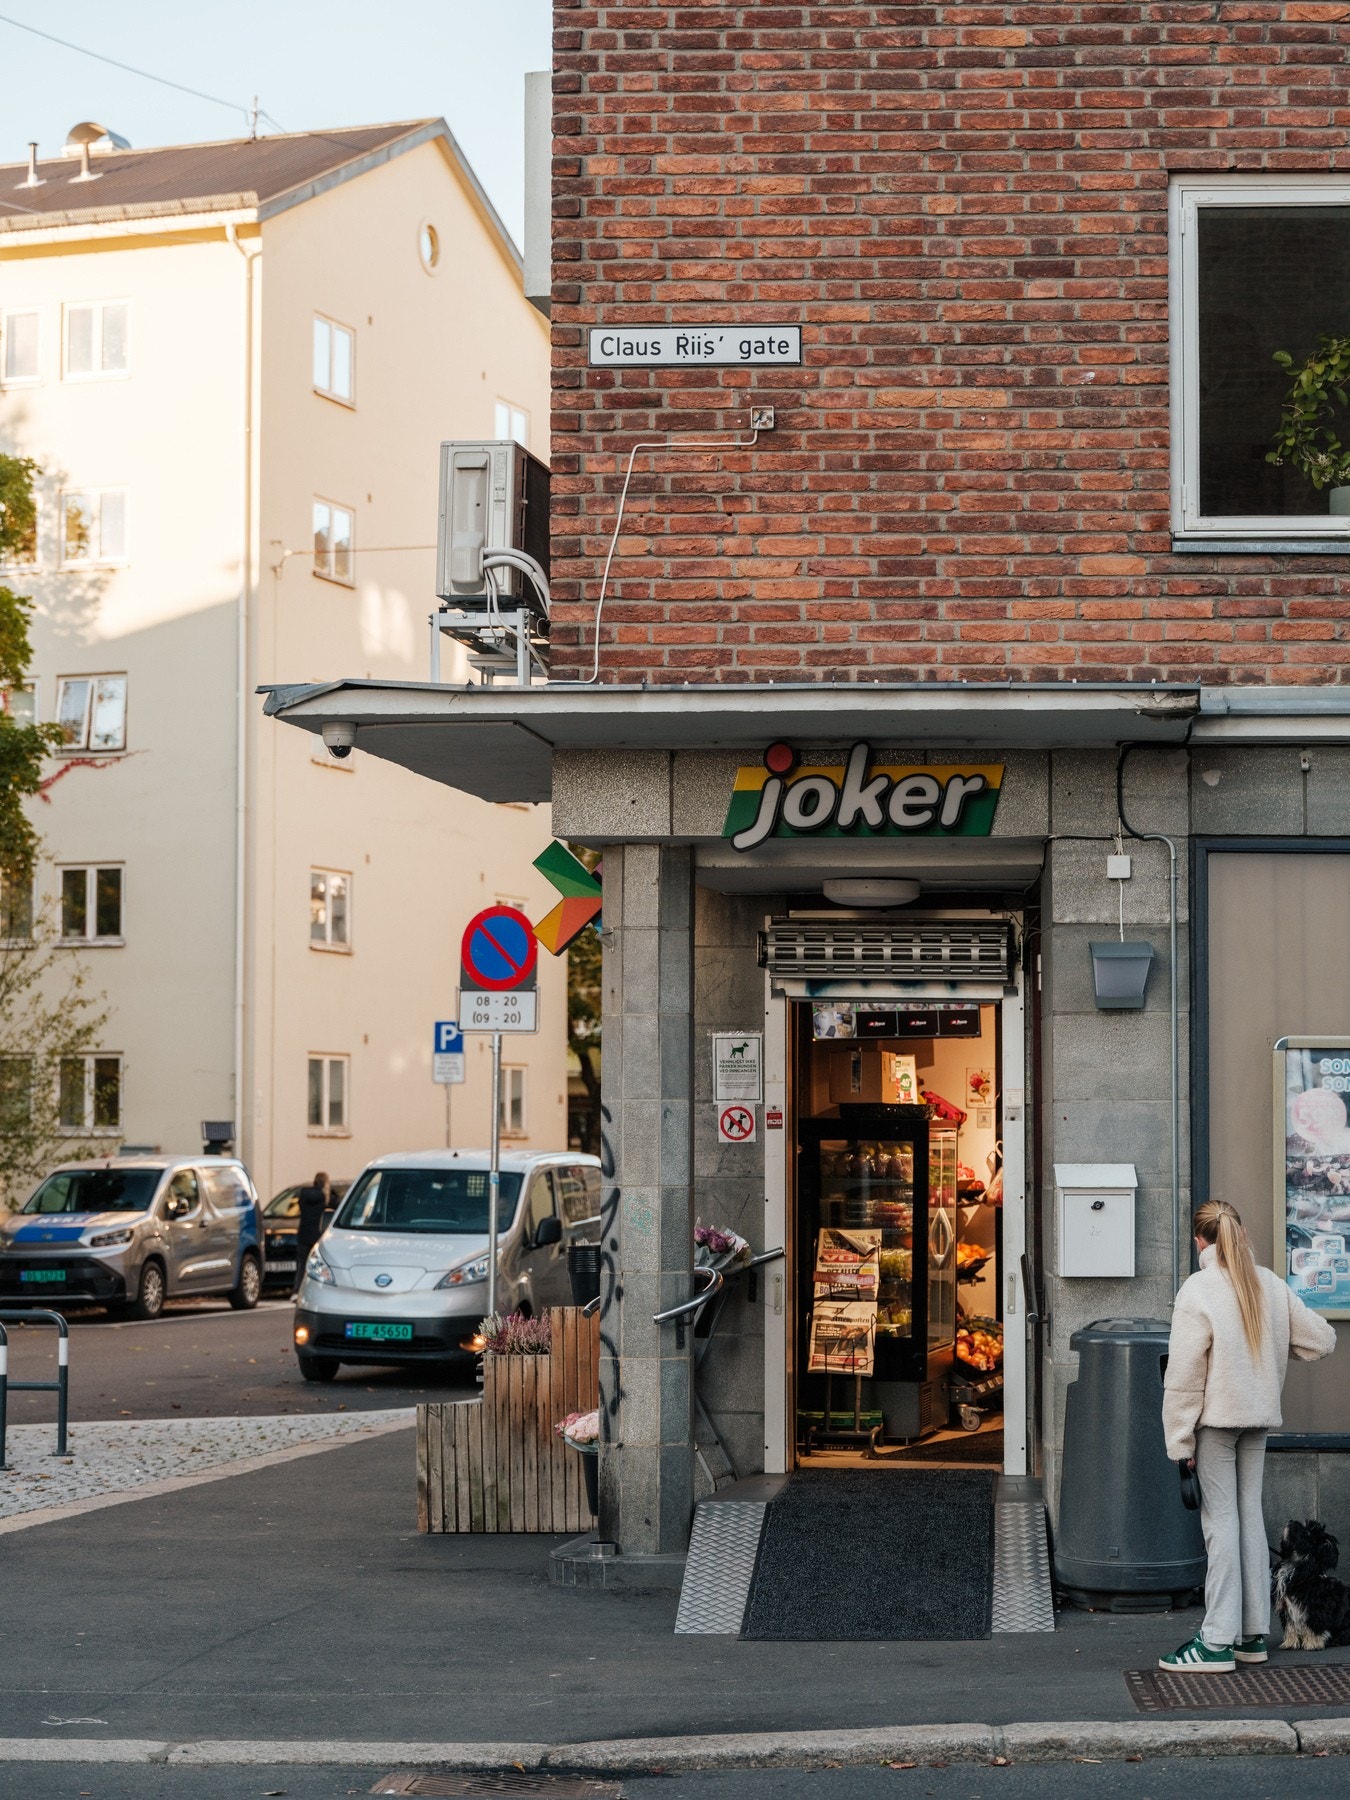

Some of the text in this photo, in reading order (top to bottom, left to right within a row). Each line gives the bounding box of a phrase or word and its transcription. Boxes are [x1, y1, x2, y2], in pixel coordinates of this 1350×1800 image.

[600, 336, 662, 357] Claus
[738, 335, 790, 360] gate
[730, 741, 989, 853] joker
[476, 996, 490, 1007] 08
[503, 996, 518, 1007] 20
[472, 1011, 490, 1024] (09
[503, 1011, 522, 1024] 20)
[440, 1024, 458, 1050] P
[1297, 1286, 1319, 1296] Nyhet!
[355, 1324, 409, 1337] EF 45650
